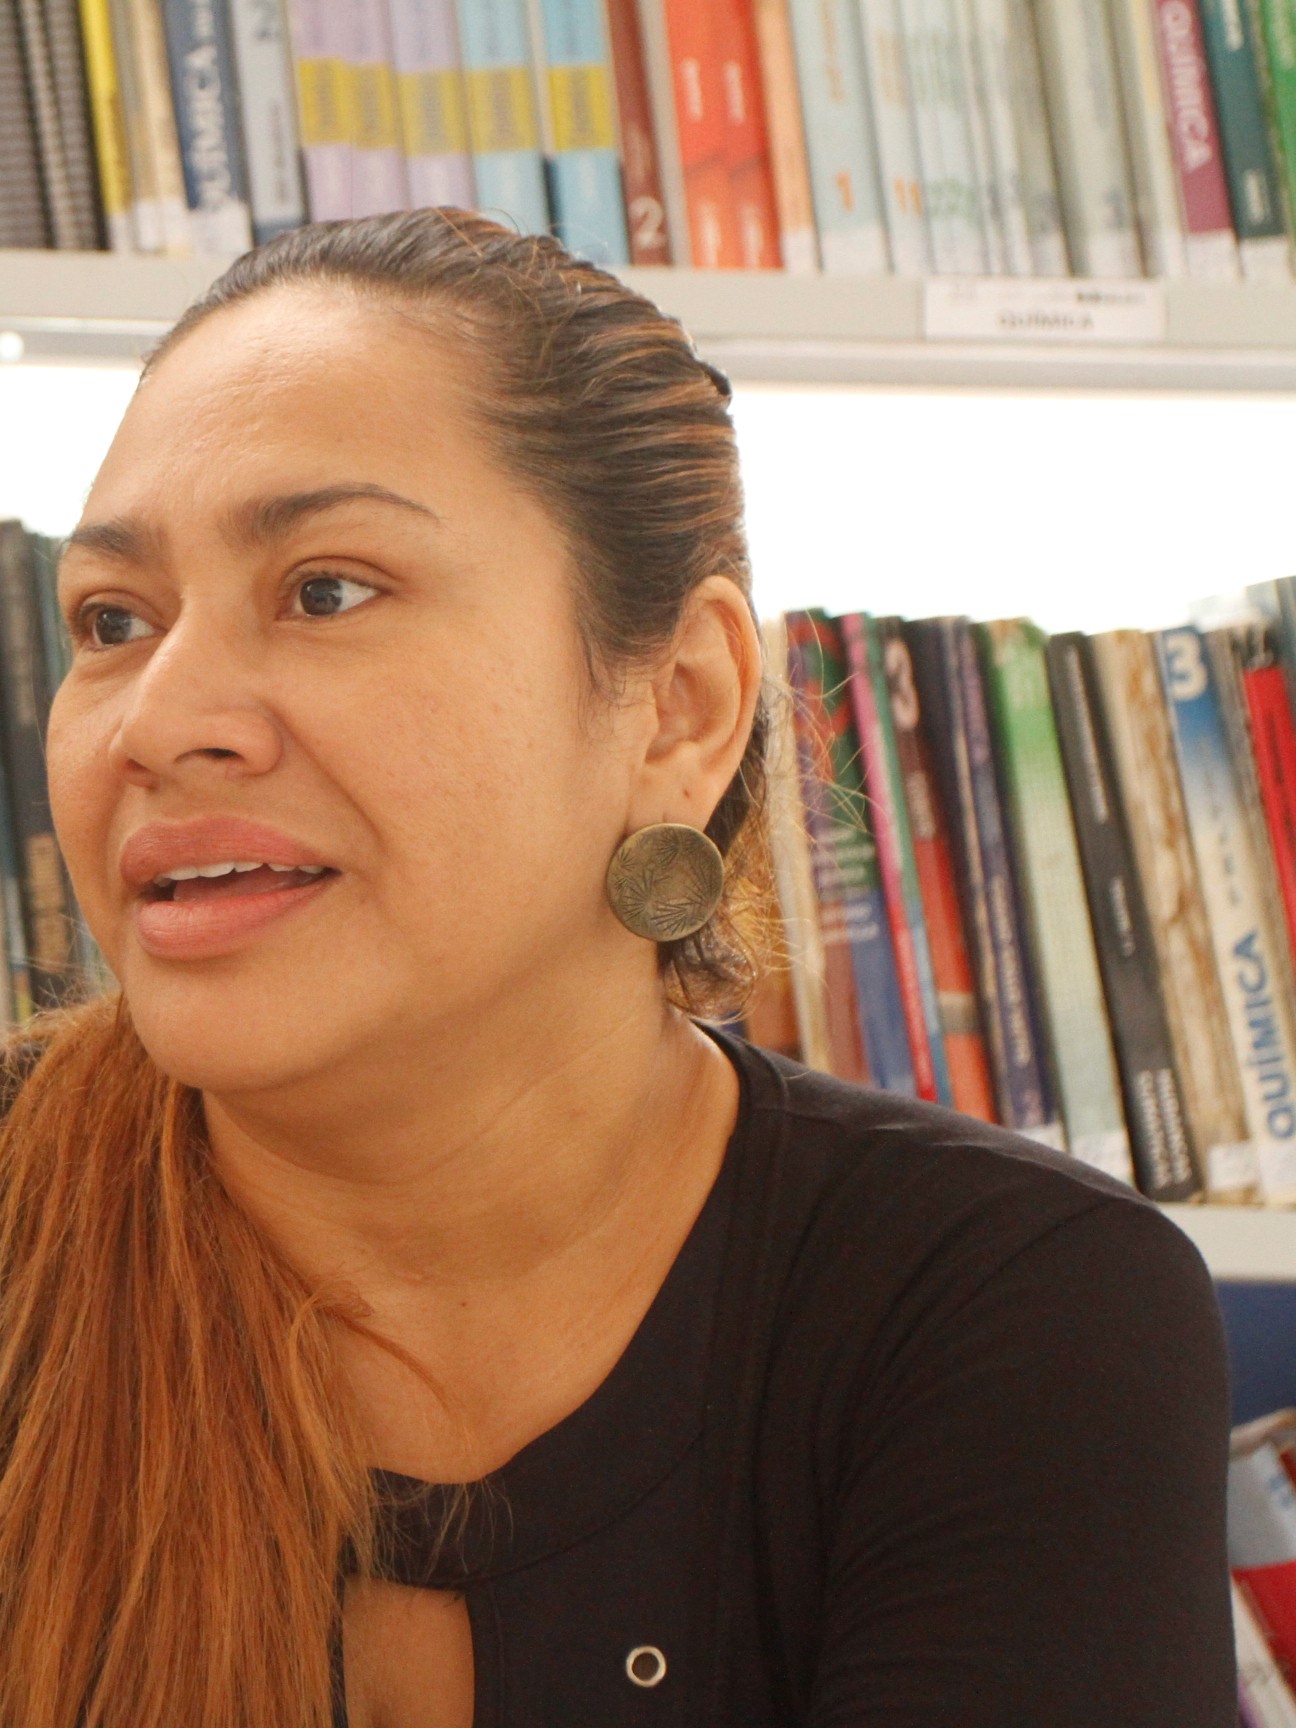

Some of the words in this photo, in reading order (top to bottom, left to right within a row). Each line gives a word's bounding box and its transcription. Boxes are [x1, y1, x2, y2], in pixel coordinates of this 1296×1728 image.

[628, 195, 667, 250] 2
[1165, 630, 1210, 702] 3
[1227, 930, 1295, 1141] QUÍMICA
